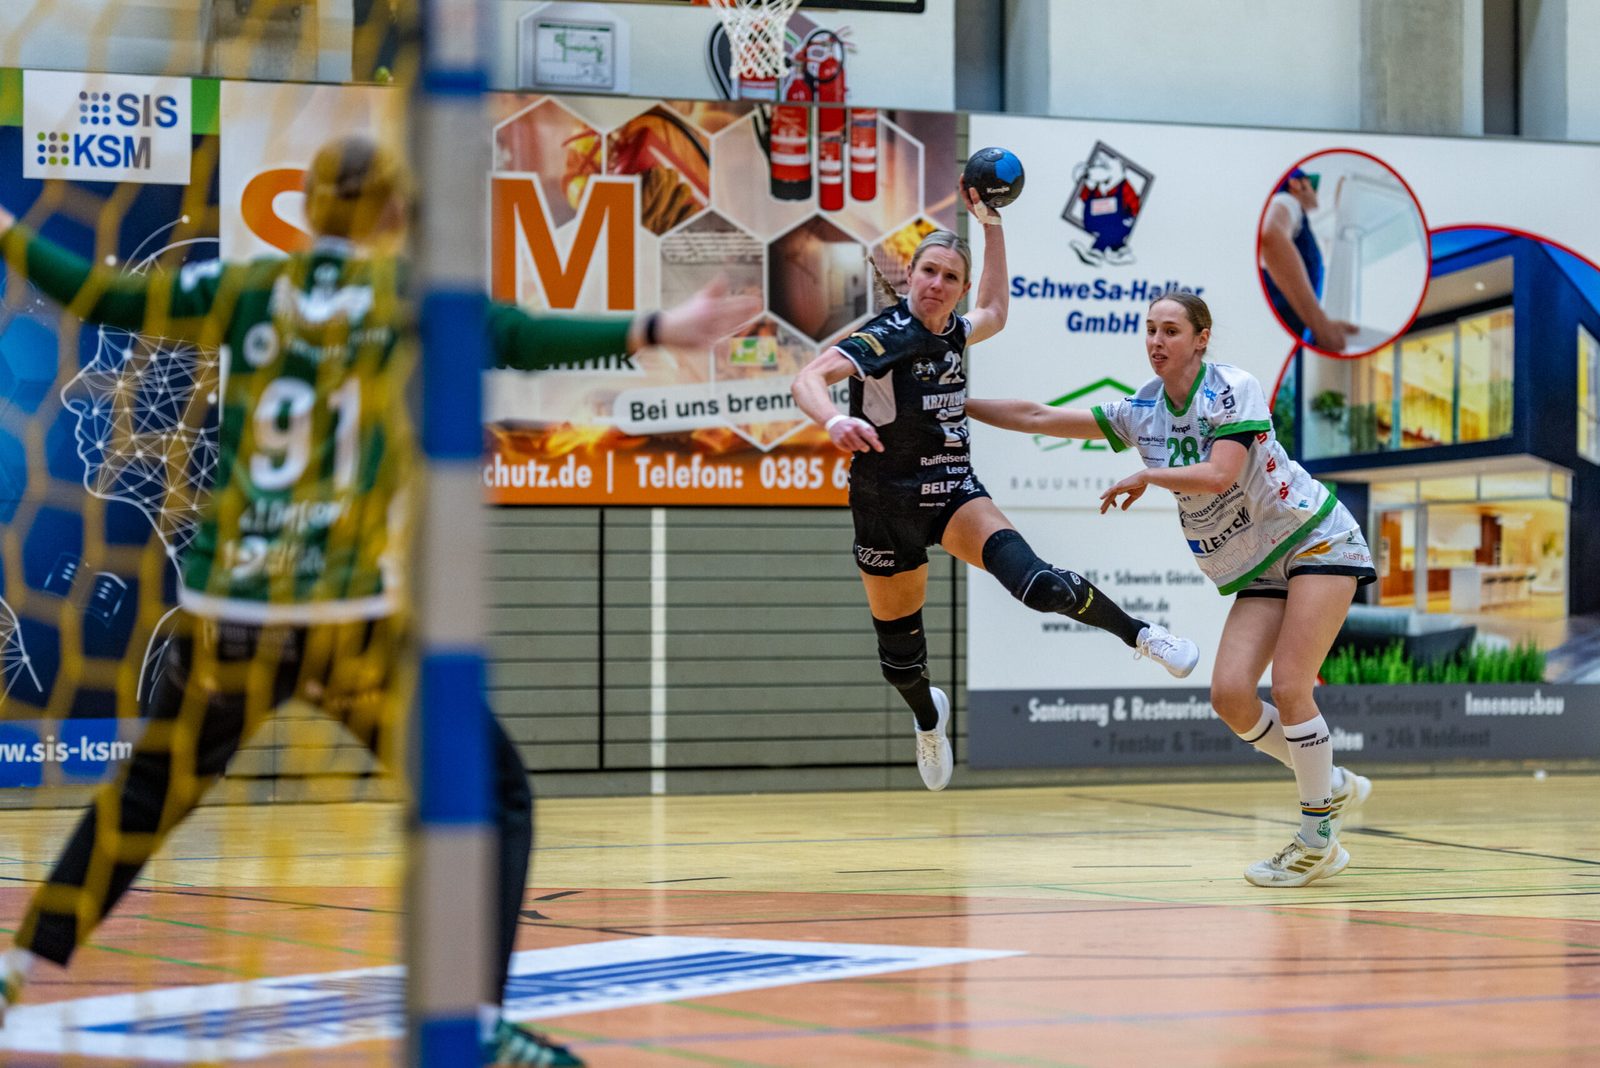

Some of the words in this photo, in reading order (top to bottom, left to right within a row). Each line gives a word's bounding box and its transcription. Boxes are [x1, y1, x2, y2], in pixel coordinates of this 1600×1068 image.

[116, 93, 178, 128] SIS
[73, 133, 151, 170] KSM
[1067, 311, 1140, 334] GmbH
[629, 400, 668, 422] Bei
[676, 396, 720, 418] uns
[727, 389, 799, 414] brenn
[250, 377, 362, 491] 91
[1167, 436, 1200, 468] 28
[482, 453, 593, 488] chutz.de
[635, 453, 744, 489] Telefon:
[760, 456, 824, 490] 0385
[832, 457, 852, 490] 6
[921, 480, 961, 495] BELF
[1028, 697, 1109, 727] Sanierung
[1112, 696, 1127, 721] &
[1131, 695, 1219, 721] Restaurier
[1465, 689, 1565, 716] Innenausbau
